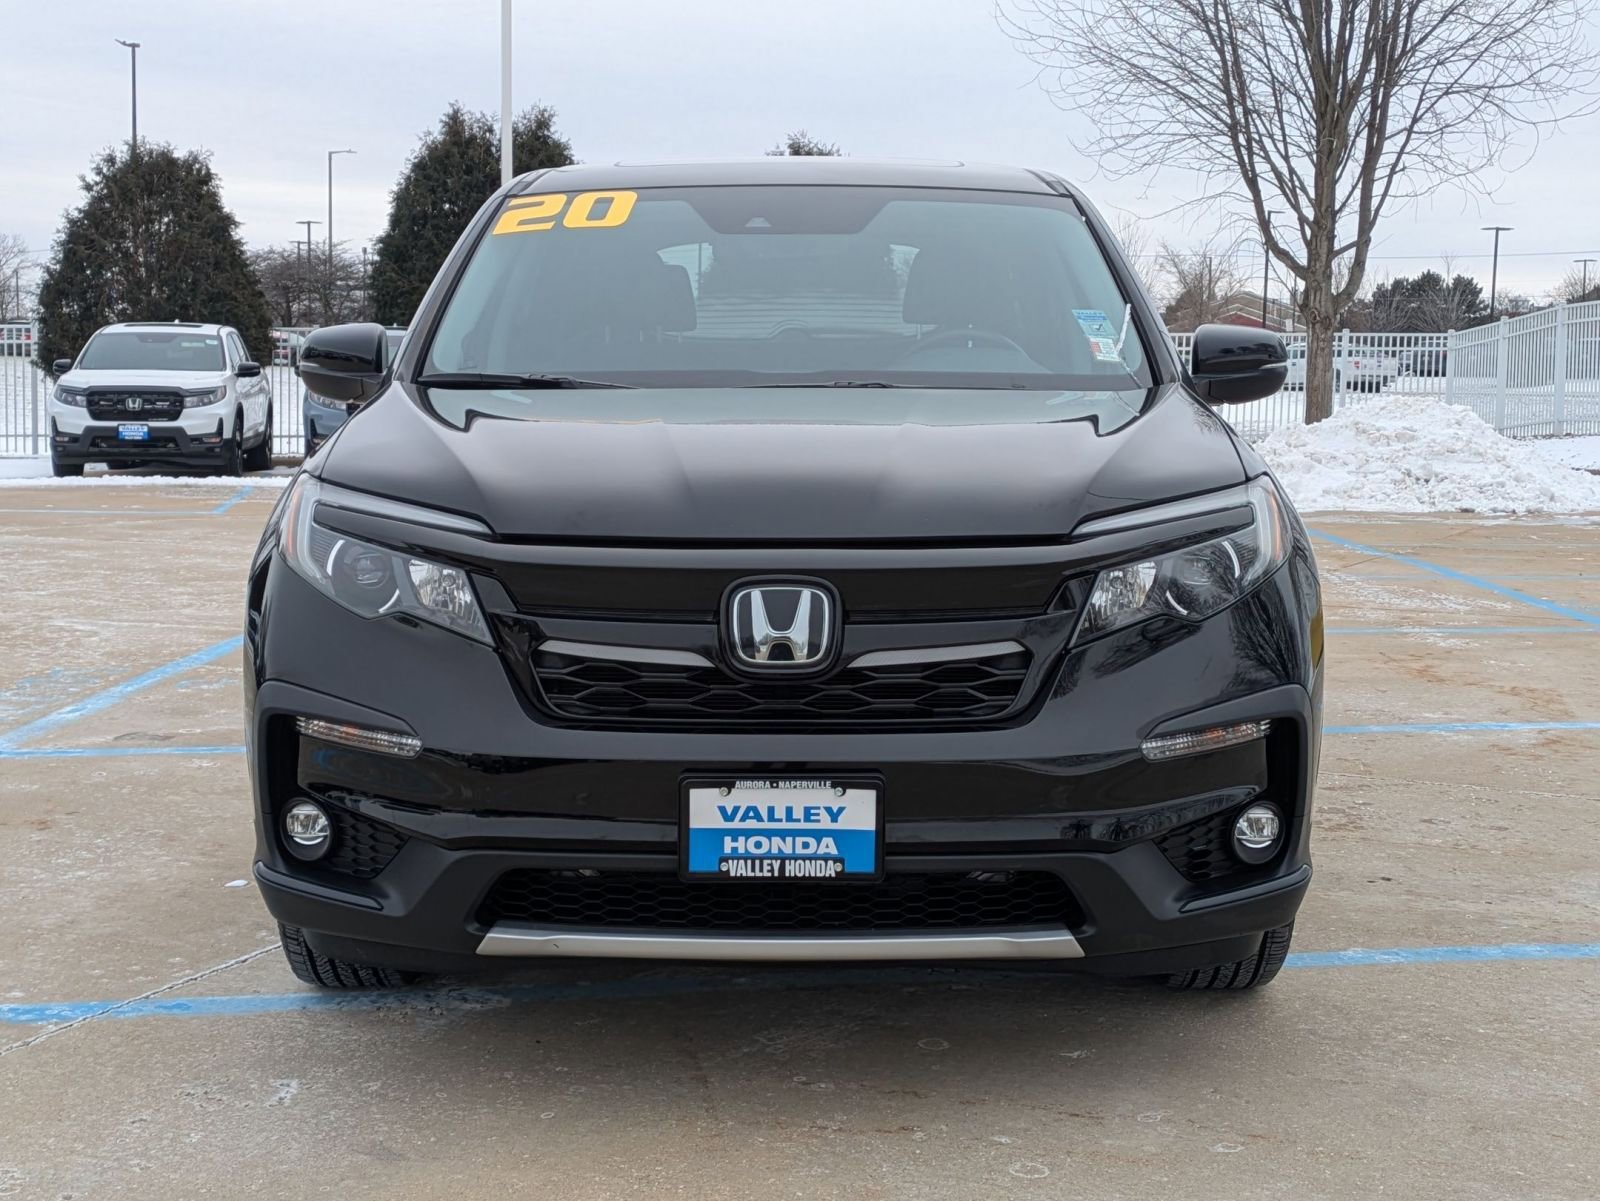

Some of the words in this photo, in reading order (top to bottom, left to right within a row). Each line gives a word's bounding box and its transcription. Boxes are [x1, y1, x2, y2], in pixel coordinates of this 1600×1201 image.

[492, 190, 638, 235] 20
[735, 780, 771, 789] AURORA
[779, 780, 832, 789] NAPERVILLE
[717, 805, 847, 823] VALLEY
[723, 836, 838, 855] HONDA
[728, 859, 781, 877] VALLEY
[785, 860, 836, 877] HONDA
